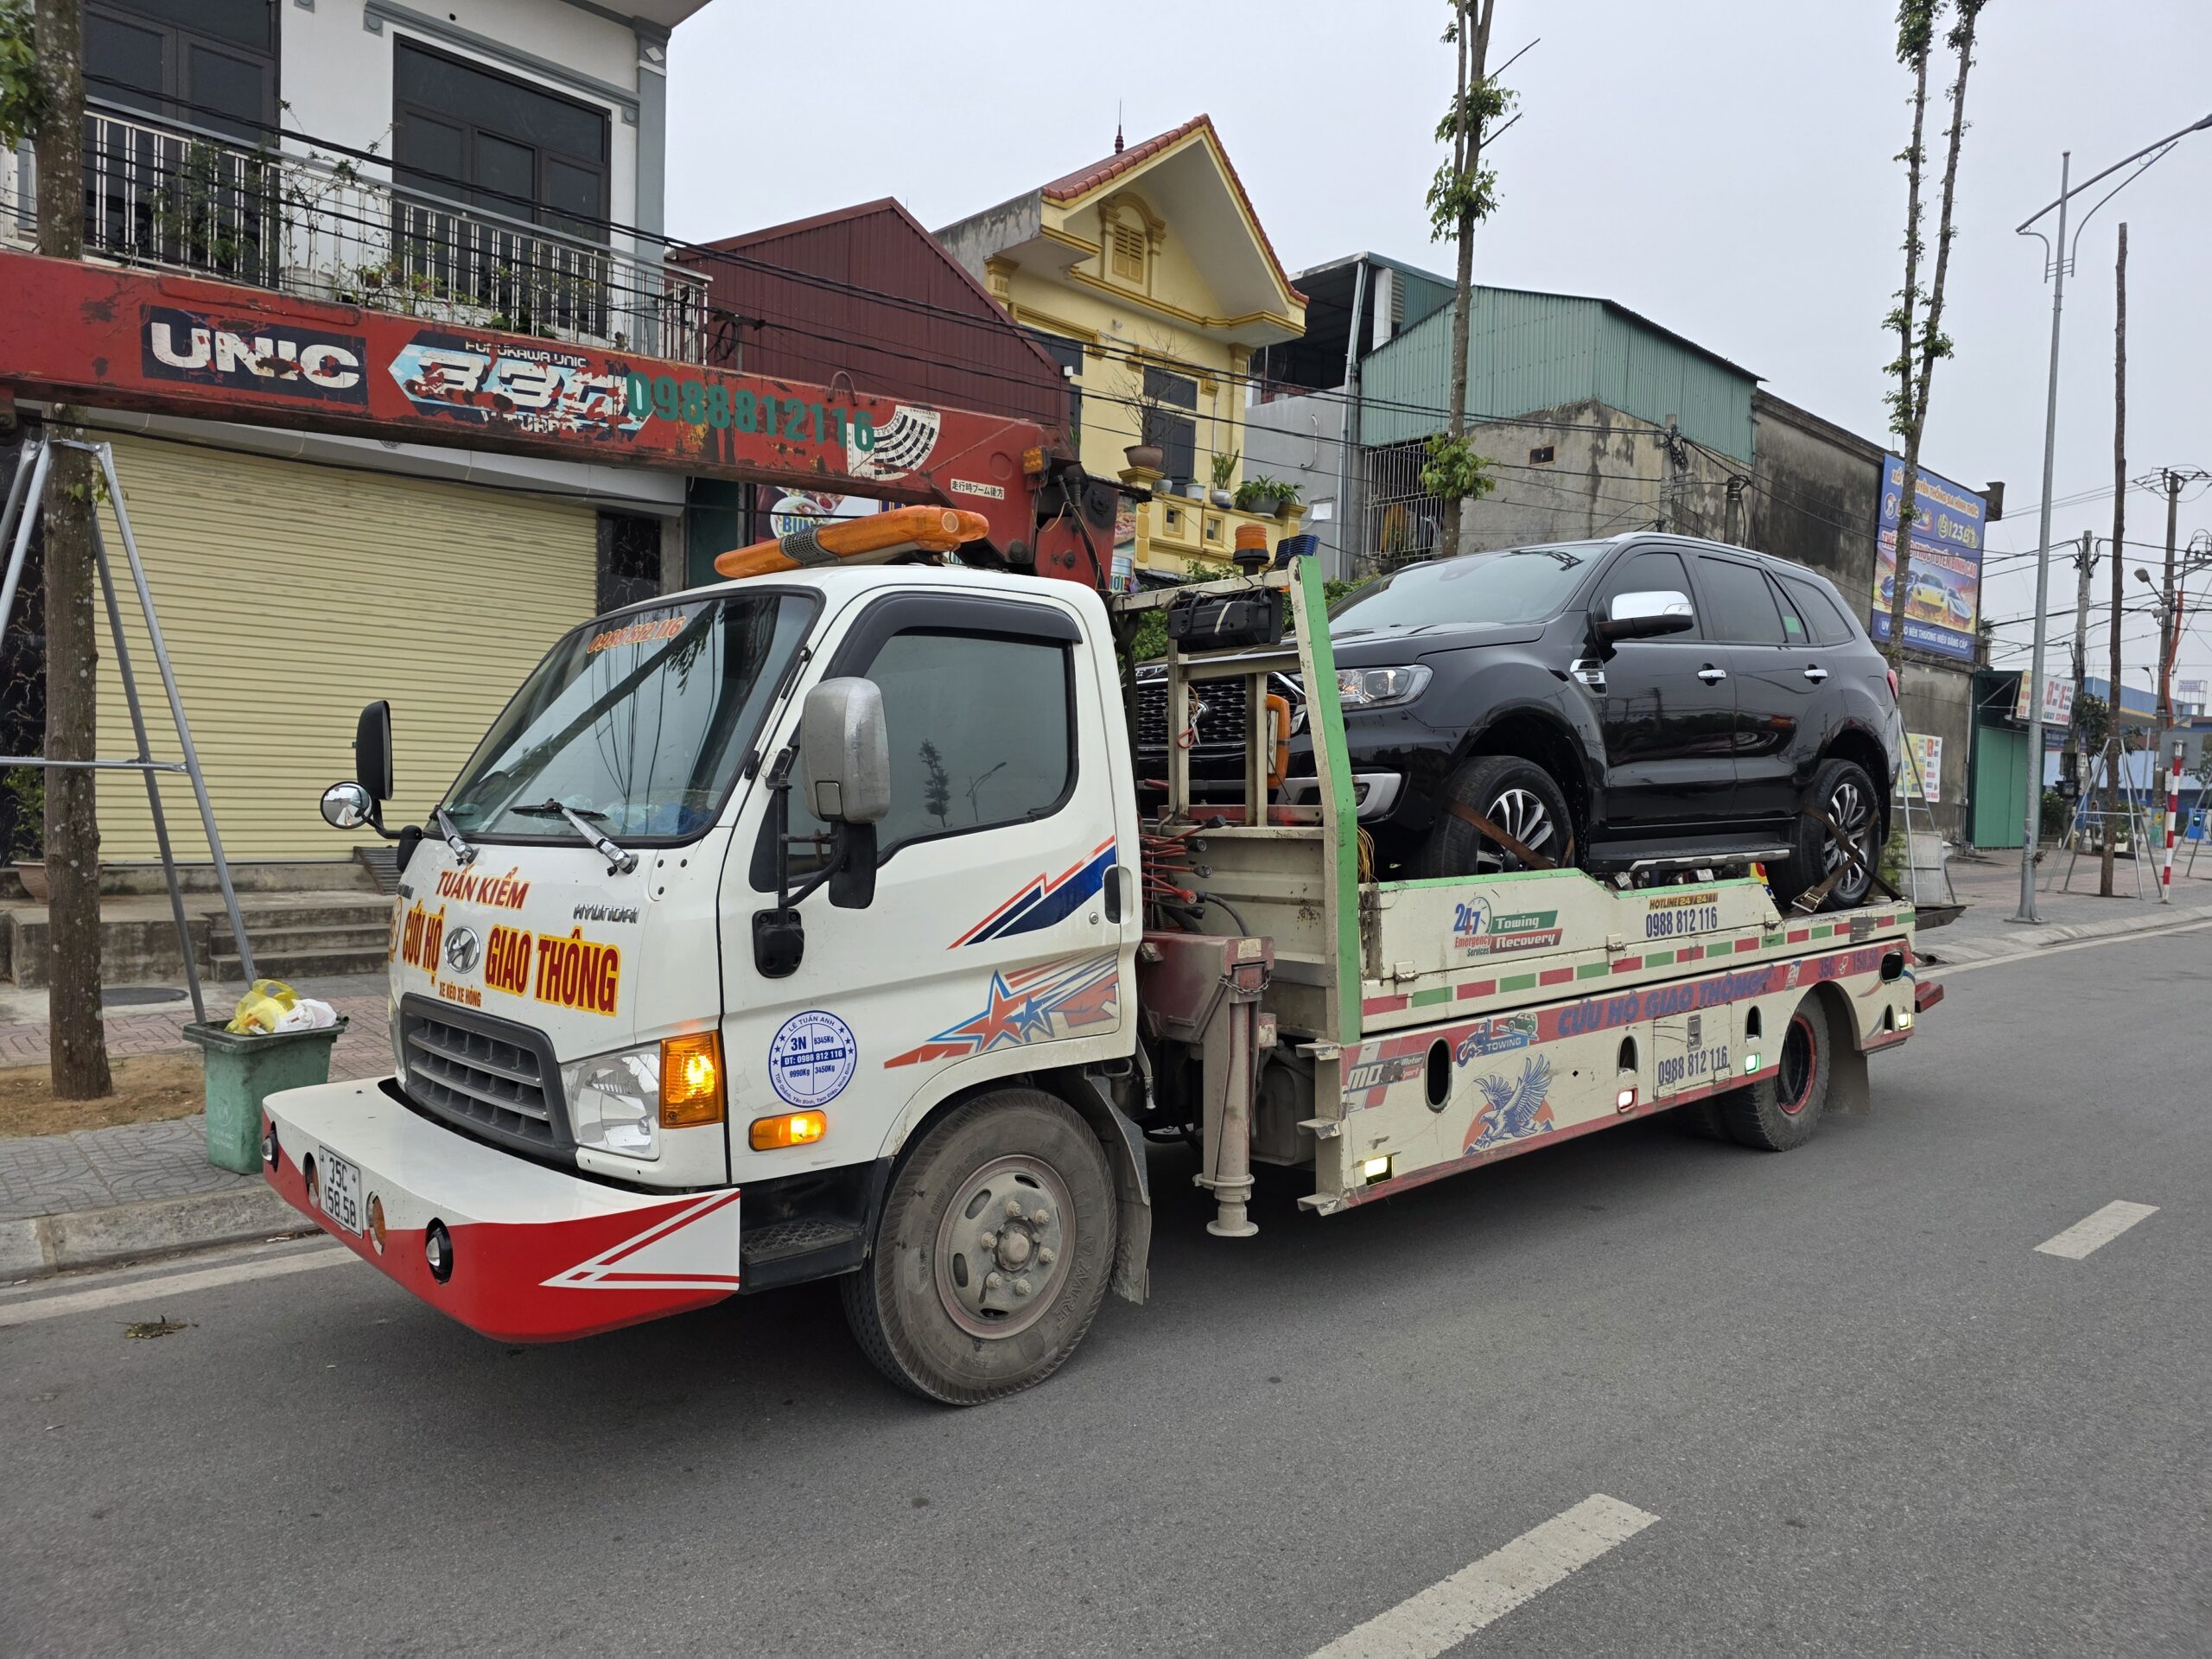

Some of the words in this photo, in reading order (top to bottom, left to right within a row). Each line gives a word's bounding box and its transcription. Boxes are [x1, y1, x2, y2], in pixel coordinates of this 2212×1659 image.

[150, 322, 360, 388] UNIC
[626, 371, 874, 453] 0988812116
[951, 480, 1004, 499] 走行時ブーム後方
[435, 863, 478, 902] TUẤN
[573, 903, 639, 924] HYUNDAI
[1649, 897, 1678, 910] HOTLINE
[1496, 916, 1539, 930] Towing
[1646, 911, 1674, 938] 0988
[1676, 908, 1696, 933] 812
[1699, 906, 1717, 930] 116
[403, 899, 425, 966] CỨU
[423, 905, 445, 984] HỘ
[1454, 936, 1492, 949] Emergency
[1496, 933, 1556, 949] Recovery
[1467, 946, 1490, 957] Services
[485, 926, 531, 994] GIAO
[536, 928, 619, 1013] THÔNG
[1644, 985, 1694, 1018] GIAO
[788, 1022, 798, 1033] LÊ
[820, 1017, 836, 1027] ANH
[791, 1036, 807, 1052] 3N
[1486, 1037, 1522, 1052] TOWING
[798, 1054, 814, 1063] 0988
[816, 1052, 829, 1060] 812
[830, 1050, 843, 1058] 116
[1401, 1057, 1423, 1066] Motor
[1658, 1056, 1684, 1085] 0988
[1688, 1050, 1707, 1077] 812
[1710, 1046, 1727, 1070] 116
[329, 1157, 347, 1192] 35C
[324, 1184, 357, 1228] 158.58
